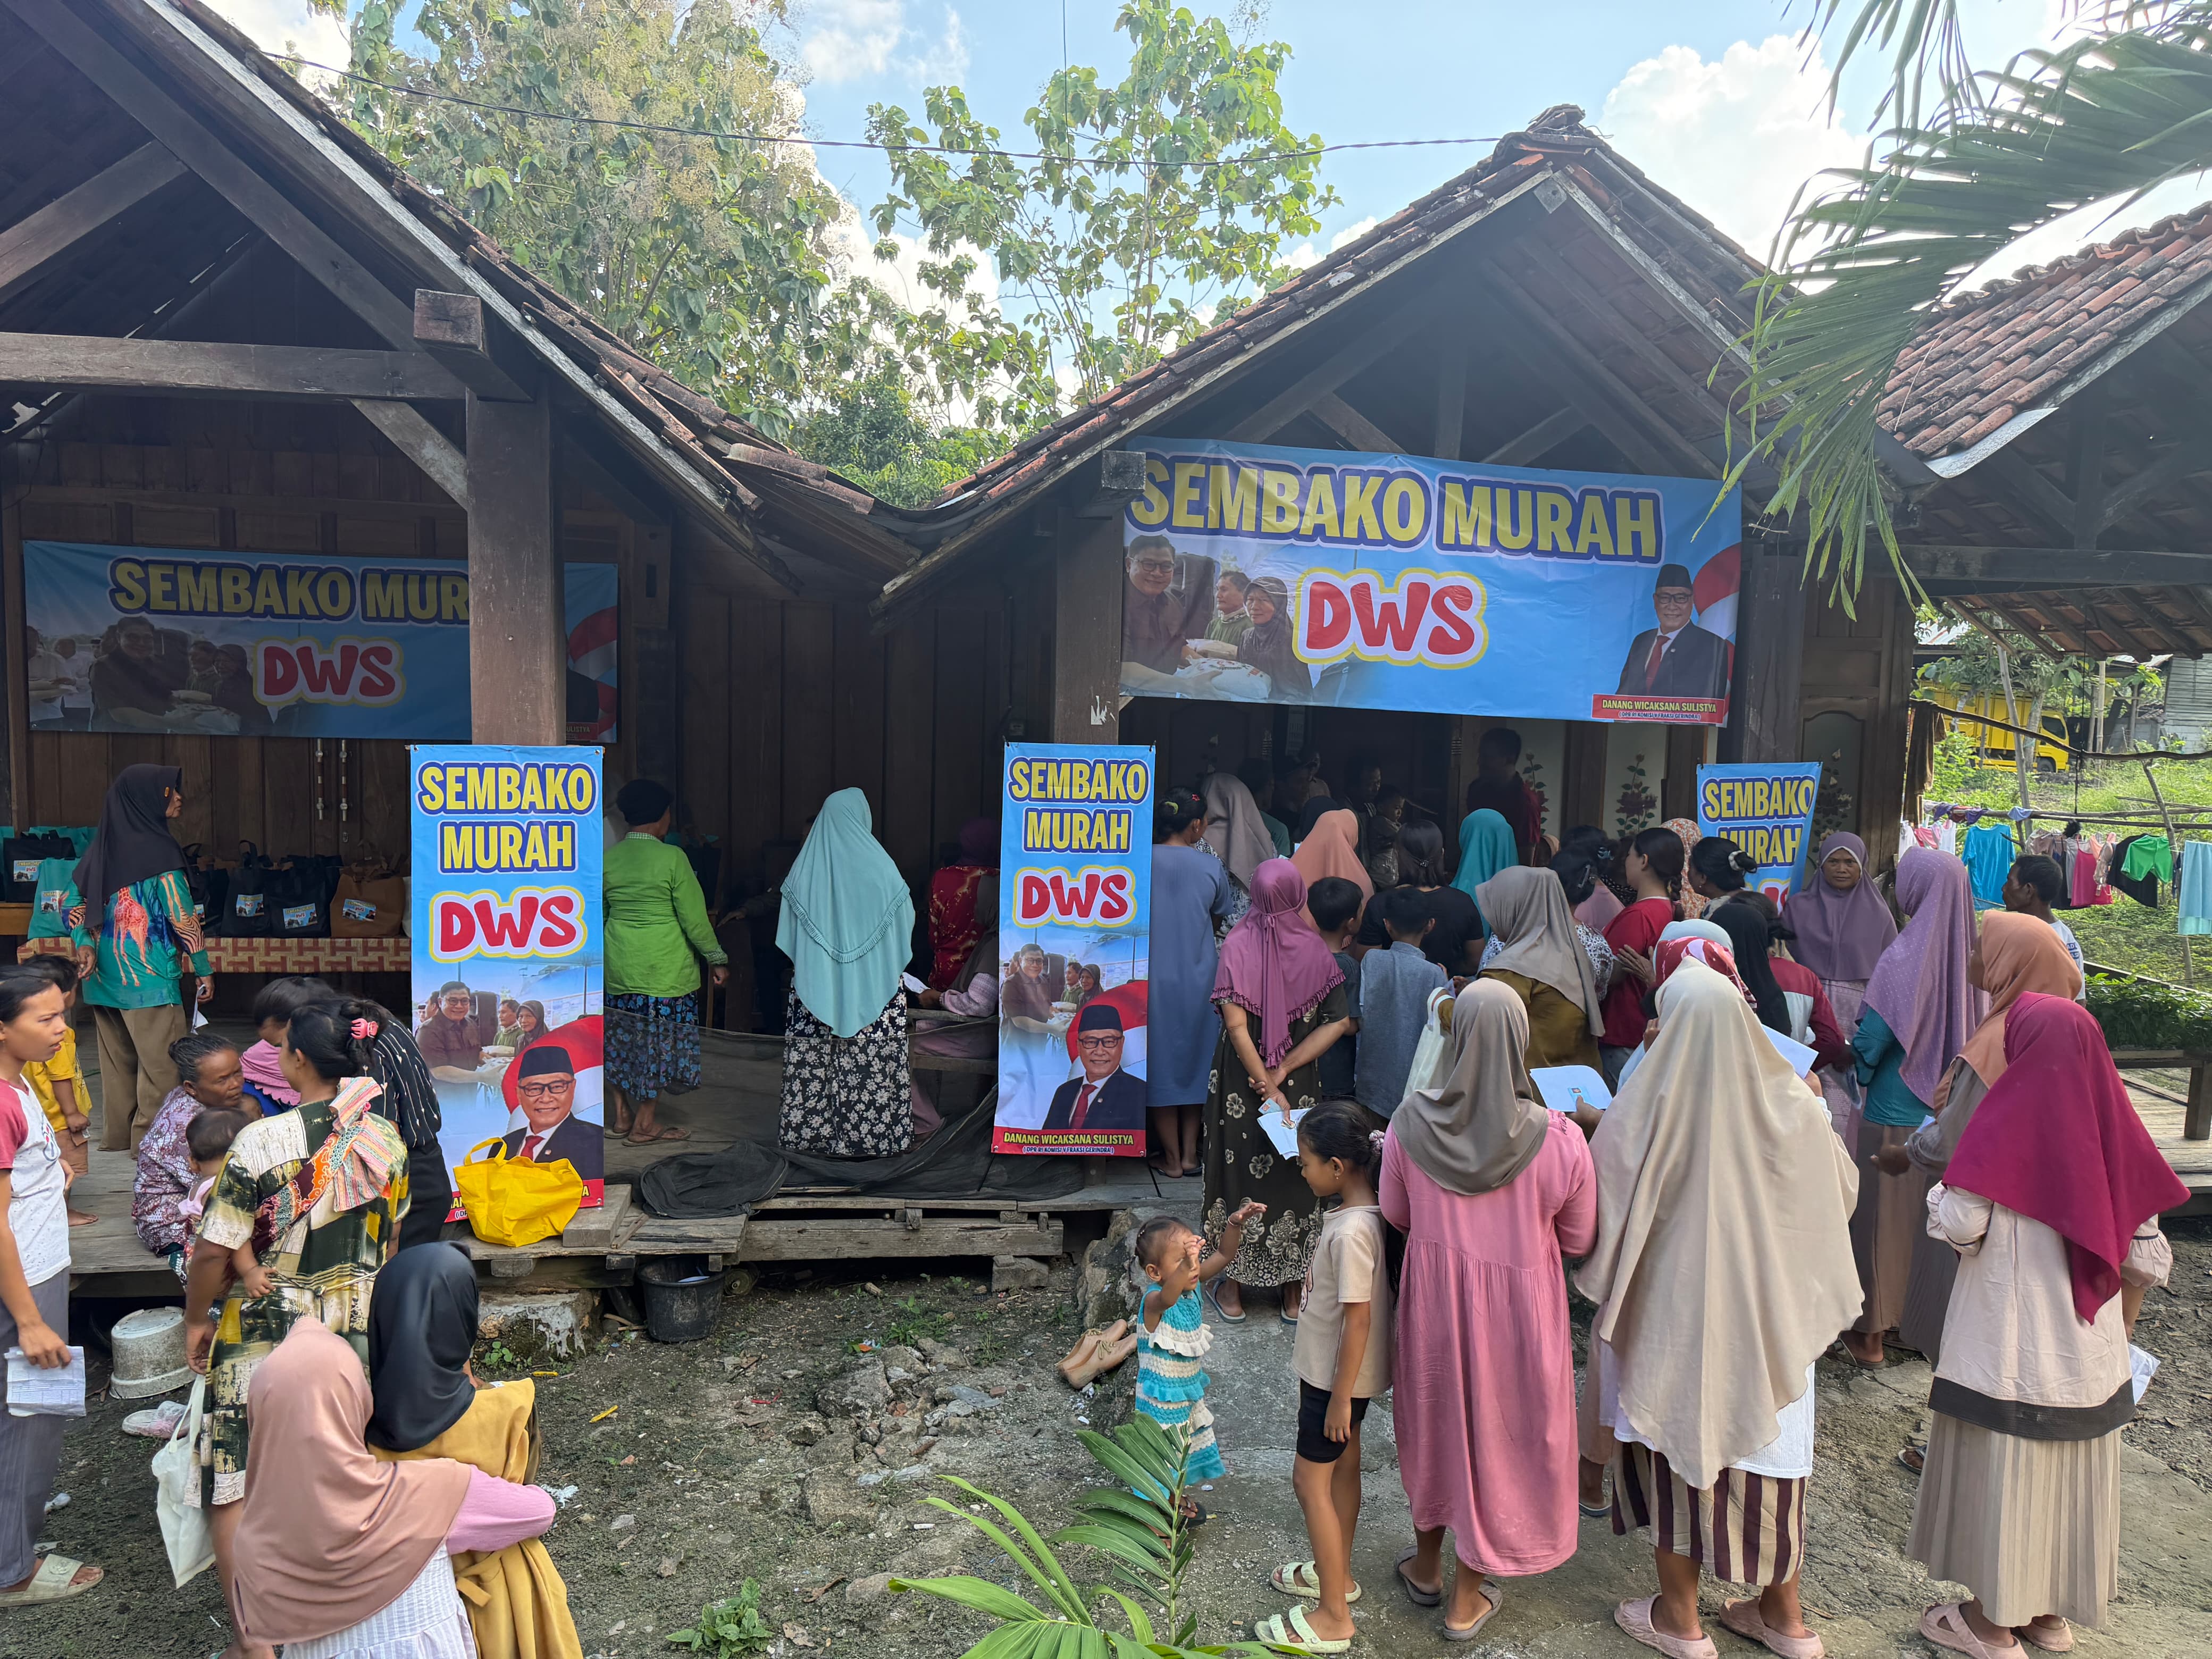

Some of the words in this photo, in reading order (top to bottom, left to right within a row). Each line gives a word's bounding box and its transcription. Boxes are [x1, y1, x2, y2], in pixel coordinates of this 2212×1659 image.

[1130, 458, 1425, 542] SEMBAKO
[1442, 481, 1656, 558] MURAH
[115, 561, 351, 617] SEMBAKO
[365, 572, 469, 621] MUR
[1305, 581, 1476, 656] DWS
[264, 644, 396, 697] DWS
[1602, 699, 1633, 710] DANANG
[1634, 701, 1680, 711] WICAKSANA
[1681, 702, 1716, 713] SULISTYA
[422, 766, 593, 811] SEMBAKO
[1011, 761, 1146, 800] SEMBAKO
[1705, 779, 1814, 819] SEMBAKO
[443, 825, 572, 869] MURAH
[1027, 811, 1129, 850] MURAH
[1021, 873, 1128, 919] DWS
[440, 895, 576, 952] DWS
[1003, 1132, 1040, 1143] DANANG
[1041, 1134, 1092, 1144] WICAKSANA
[1093, 1135, 1134, 1145] SULISTYA
